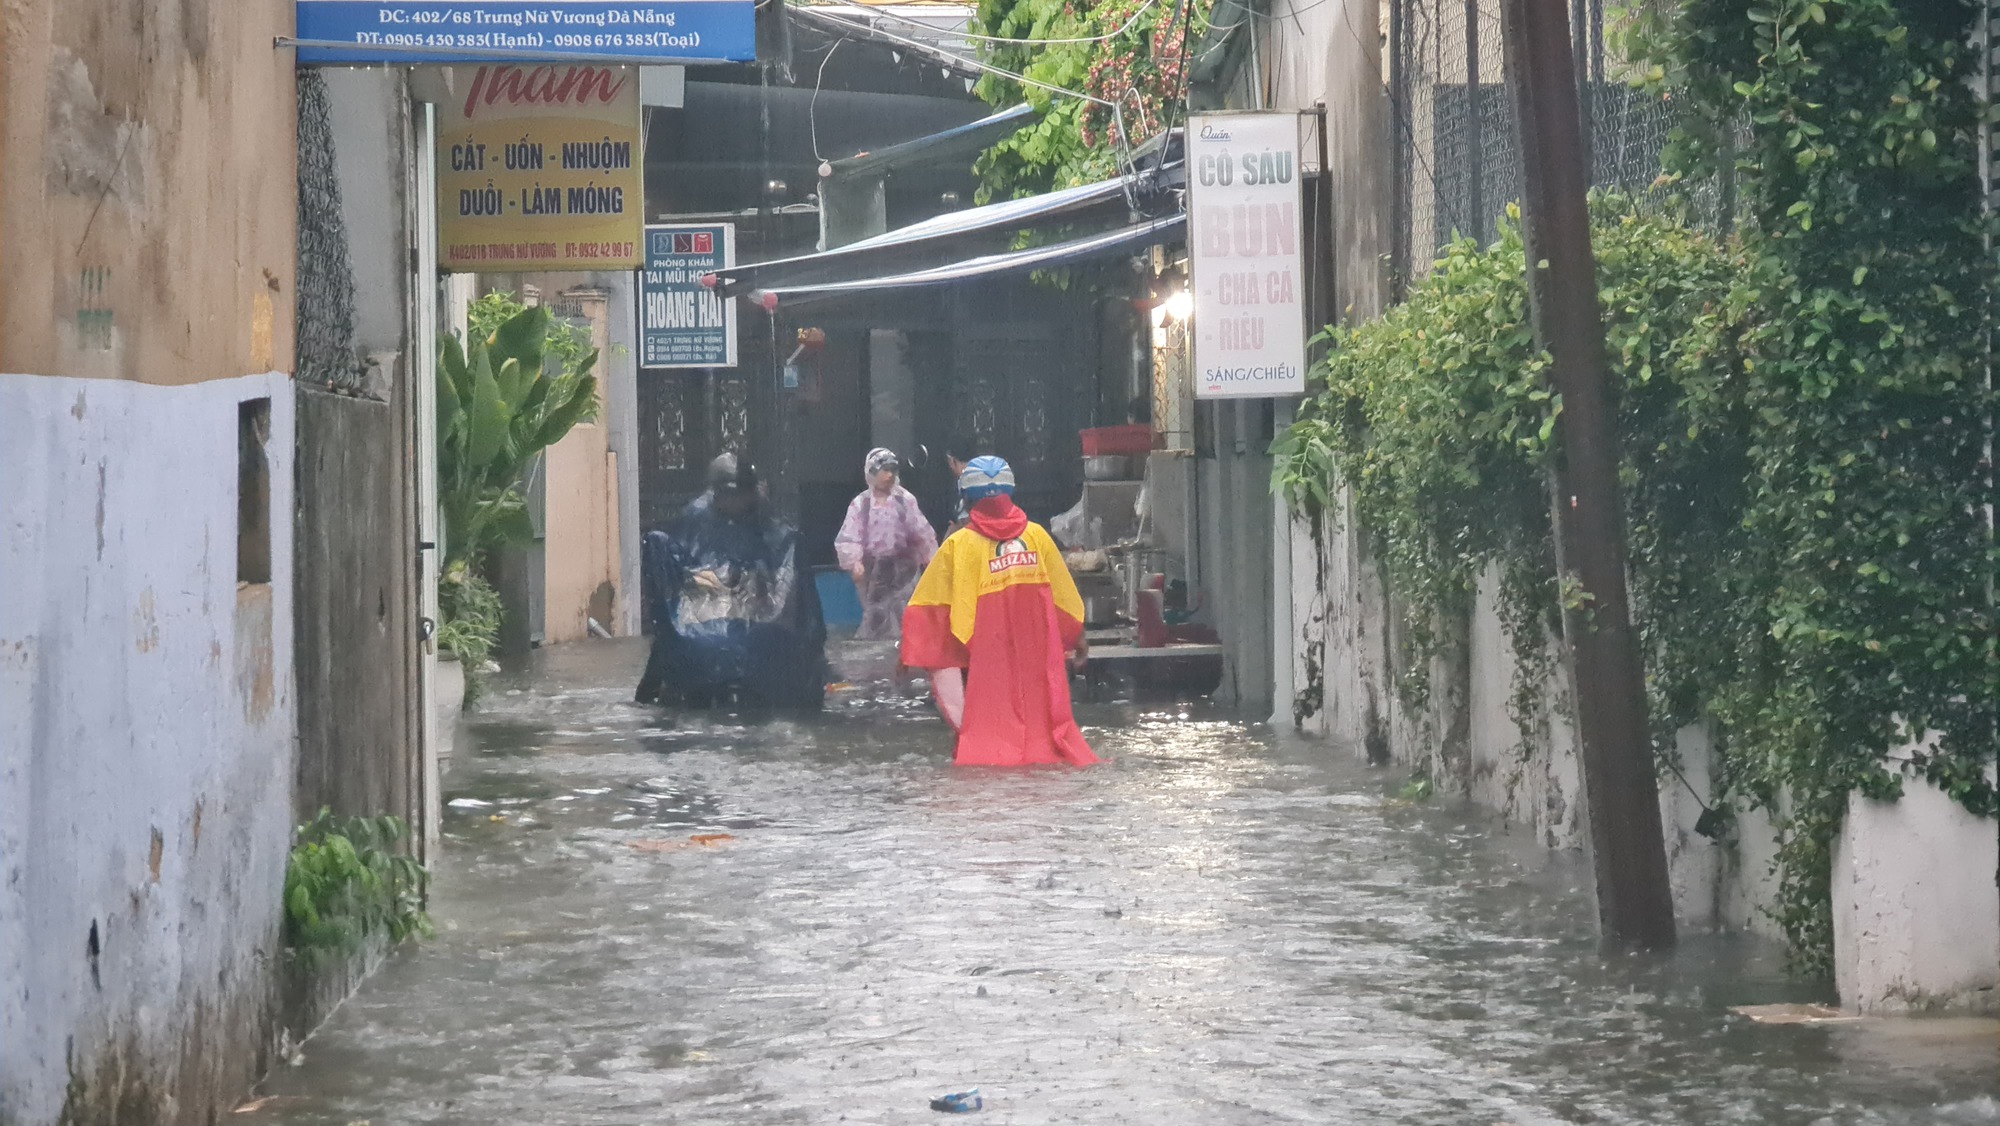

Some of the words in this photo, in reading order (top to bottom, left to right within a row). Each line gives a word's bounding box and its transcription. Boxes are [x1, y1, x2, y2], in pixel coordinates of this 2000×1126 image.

[379, 9, 410, 24] ĐC:
[411, 9, 472, 24] 402/68
[525, 10, 550, 24] Nữ
[551, 10, 605, 27] Vương
[608, 10, 630, 24] Đà
[633, 9, 676, 27] Nẵng
[425, 33, 454, 47] 430
[554, 34, 592, 47] 0908
[594, 34, 623, 47] 676
[451, 133, 487, 171] CẮT
[504, 133, 543, 170] UỐN
[562, 136, 631, 174] NHUỘM
[1199, 148, 1234, 187] CÔ
[1242, 147, 1292, 185] SÁU
[522, 182, 562, 214] LÀM
[567, 181, 623, 214] MÓNG
[1201, 195, 1295, 258] BÚN
[646, 271, 662, 284] TAI
[665, 268, 685, 283] MŨI
[653, 258, 686, 268] PHÒNG
[688, 256, 714, 267] KHÁM
[1219, 263, 1260, 306] CHẢ
[1266, 264, 1294, 304] CÁ
[646, 286, 695, 329] HOÀNG
[1219, 312, 1264, 351] RIÊU
[990, 553, 1036, 572] MEIZAN
